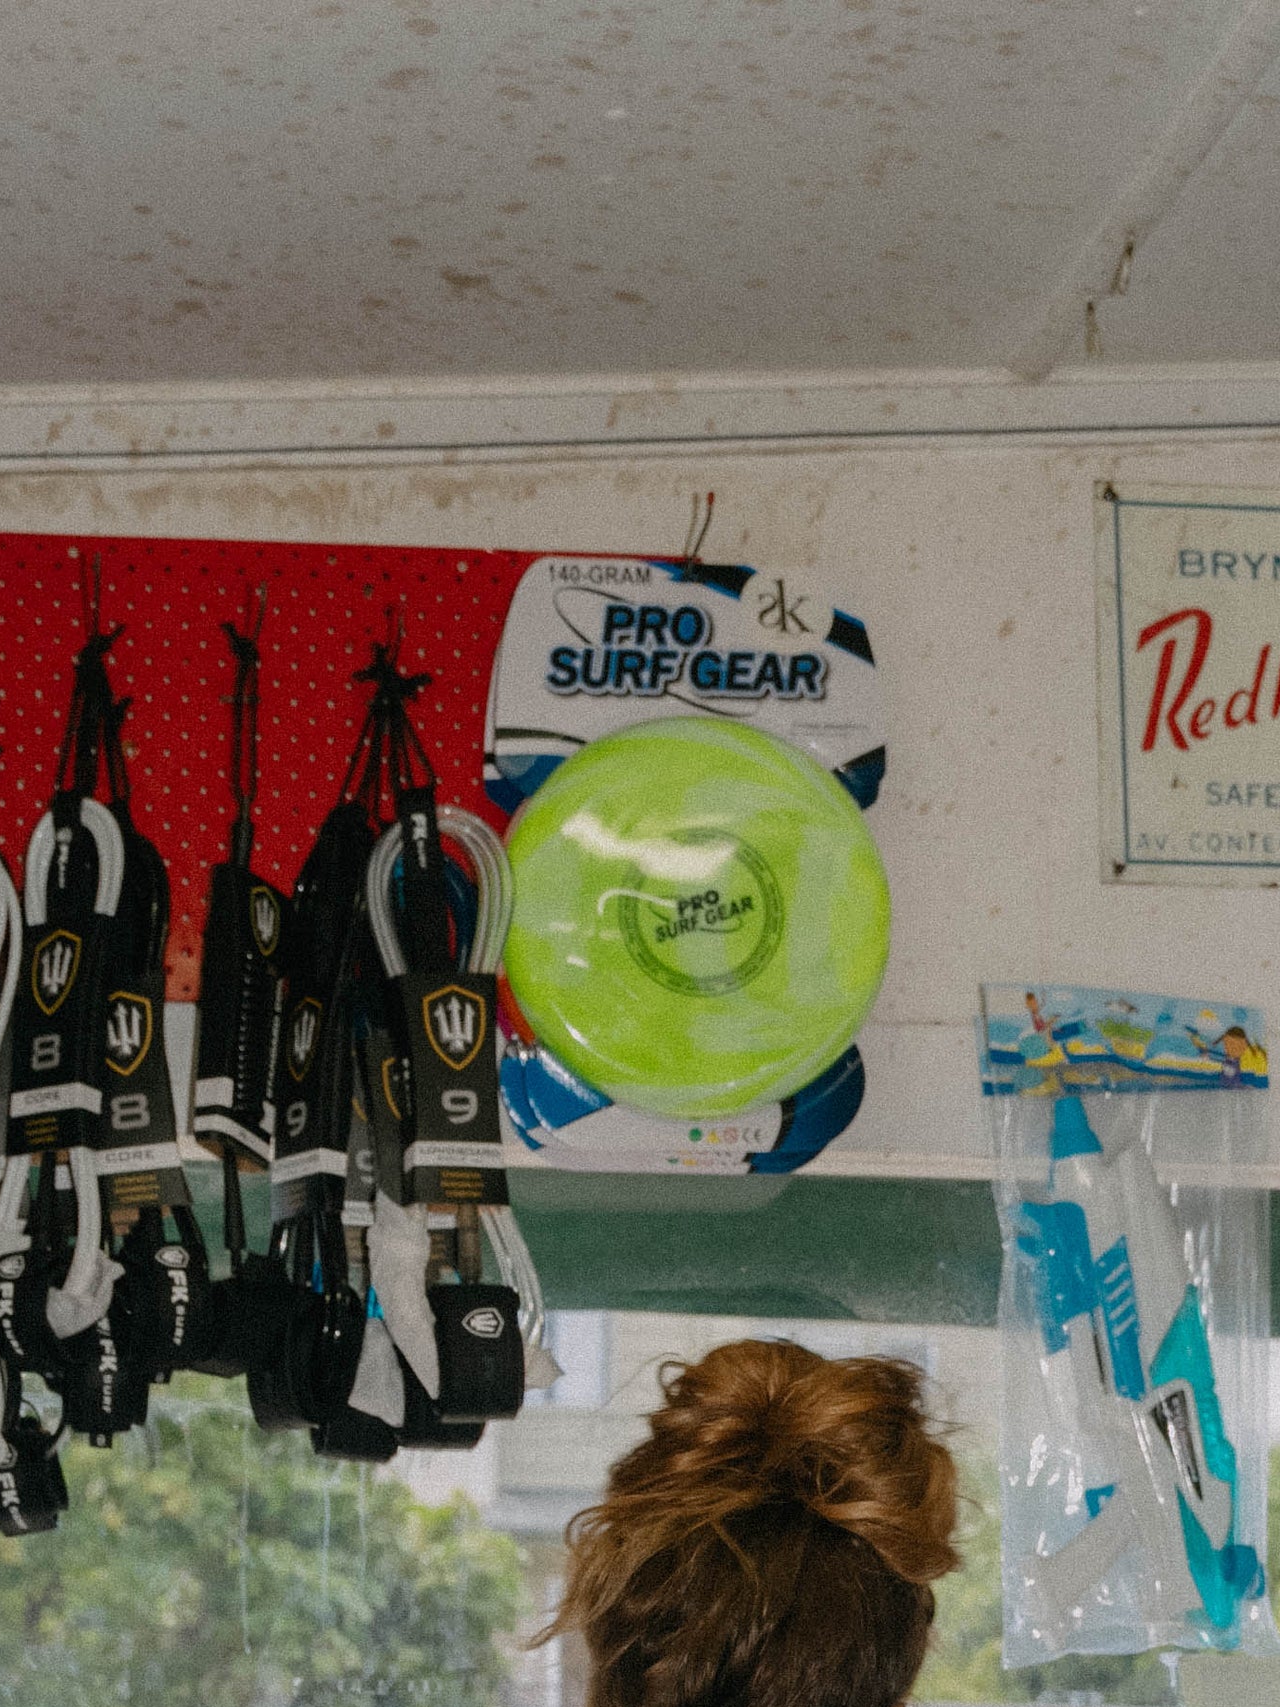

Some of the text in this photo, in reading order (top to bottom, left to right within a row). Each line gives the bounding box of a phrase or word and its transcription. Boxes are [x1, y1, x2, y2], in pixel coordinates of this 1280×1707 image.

[548, 562, 653, 585] 140-GRAM
[602, 603, 710, 648] PRO
[547, 646, 826, 697] SURF GEAR
[654, 894, 756, 944] SURF GEAR
[677, 888, 721, 916] PRO
[30, 1034, 61, 1071] 8
[109, 1093, 150, 1131] 8
[285, 1100, 308, 1138] 9
[440, 1089, 480, 1125] 9
[168, 1268, 190, 1304] FK
[98, 1338, 118, 1372] FK
